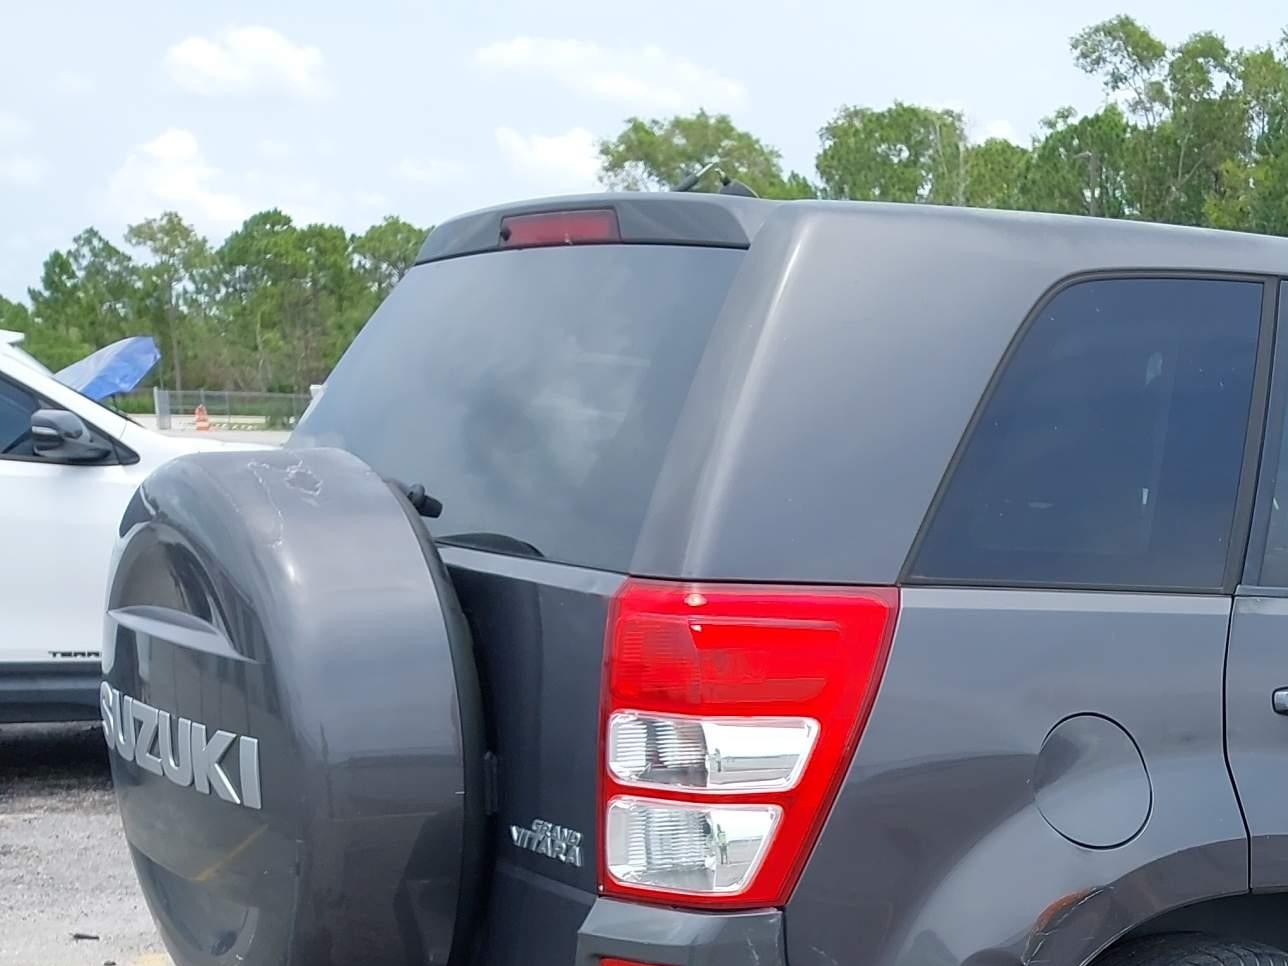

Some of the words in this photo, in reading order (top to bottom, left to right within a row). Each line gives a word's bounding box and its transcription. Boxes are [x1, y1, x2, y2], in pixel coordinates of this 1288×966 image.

[100, 681, 261, 809] SUZUKI
[511, 825, 581, 867] VITARA
[531, 819, 581, 846] GRAND
